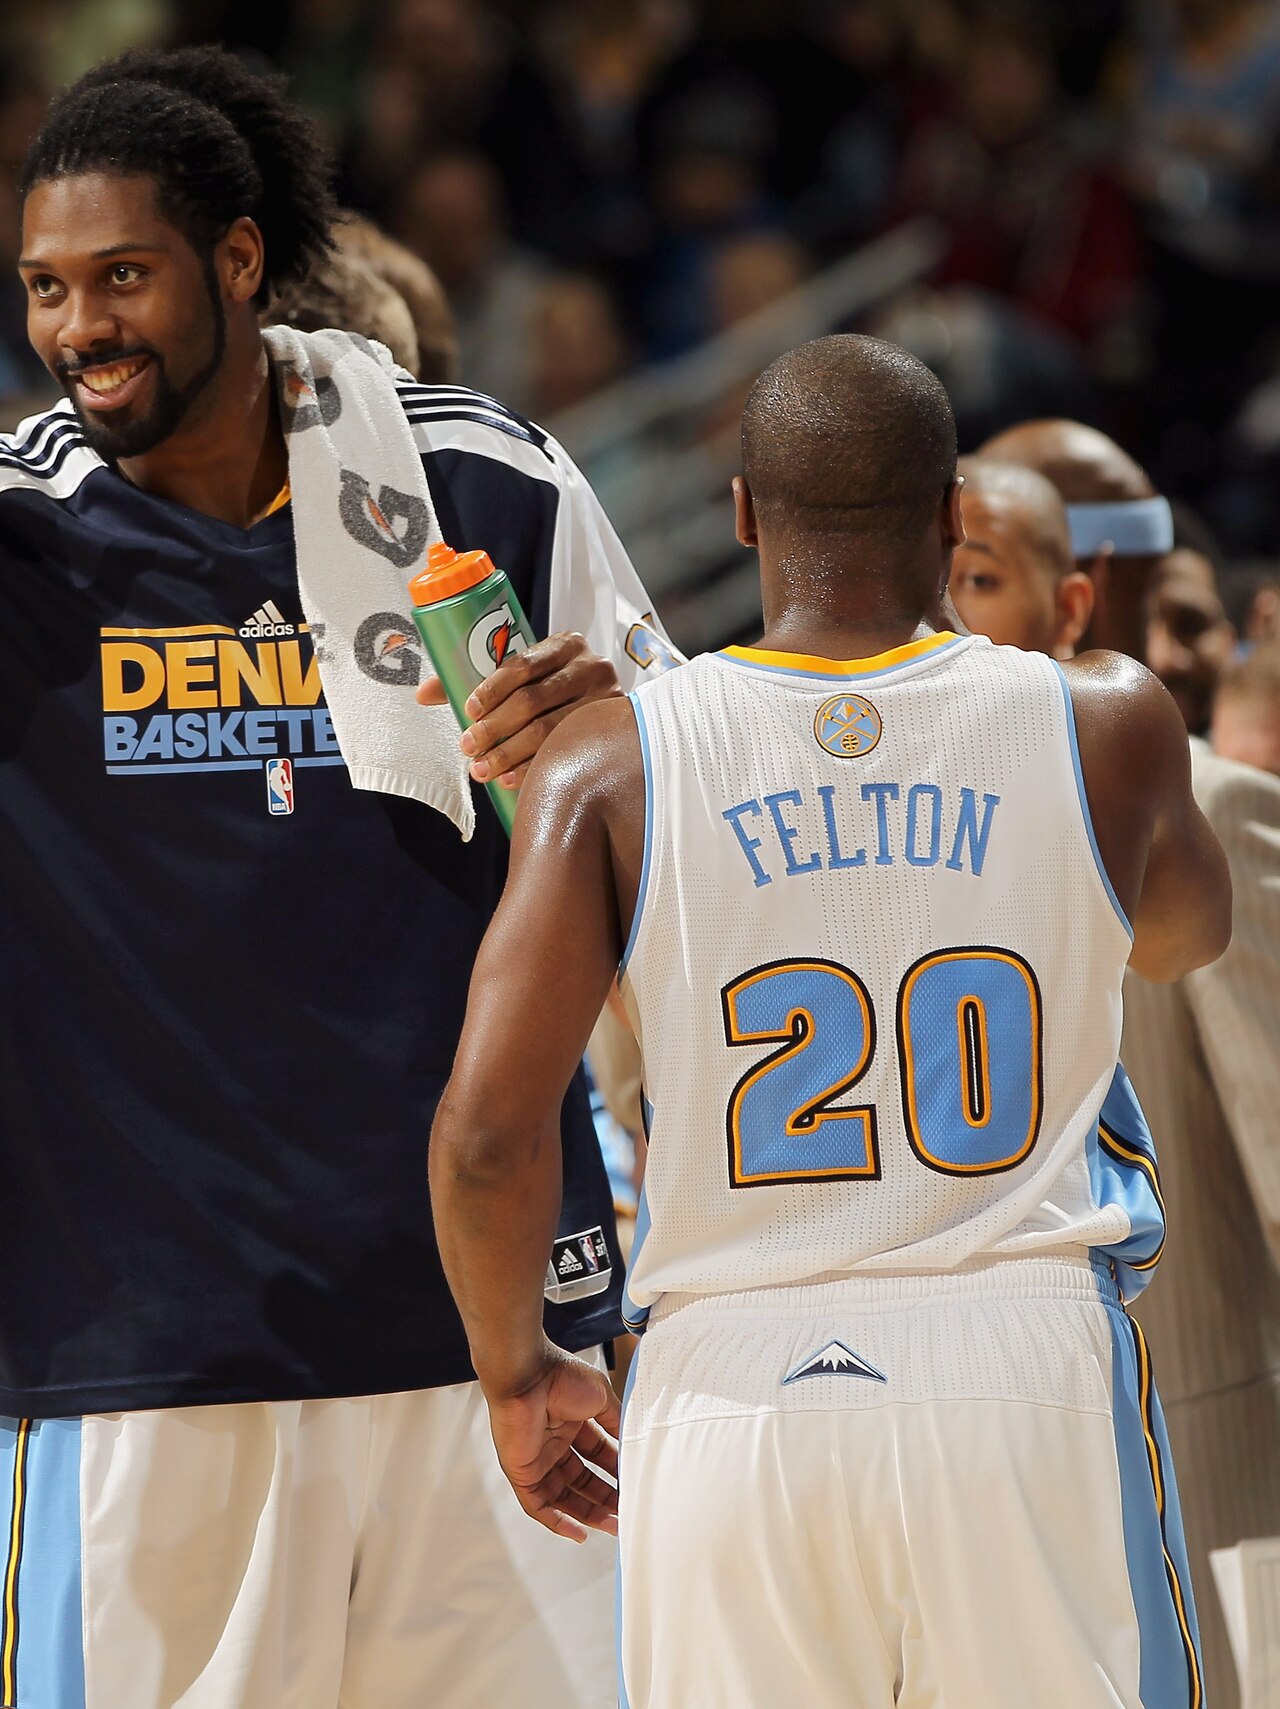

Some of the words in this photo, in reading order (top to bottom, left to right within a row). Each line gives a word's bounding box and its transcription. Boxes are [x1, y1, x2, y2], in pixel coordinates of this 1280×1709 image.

[239, 622, 295, 638] adidas
[721, 783, 1001, 888] FELTON
[720, 945, 1044, 1190] 20
[559, 1263, 583, 1274] adidas
